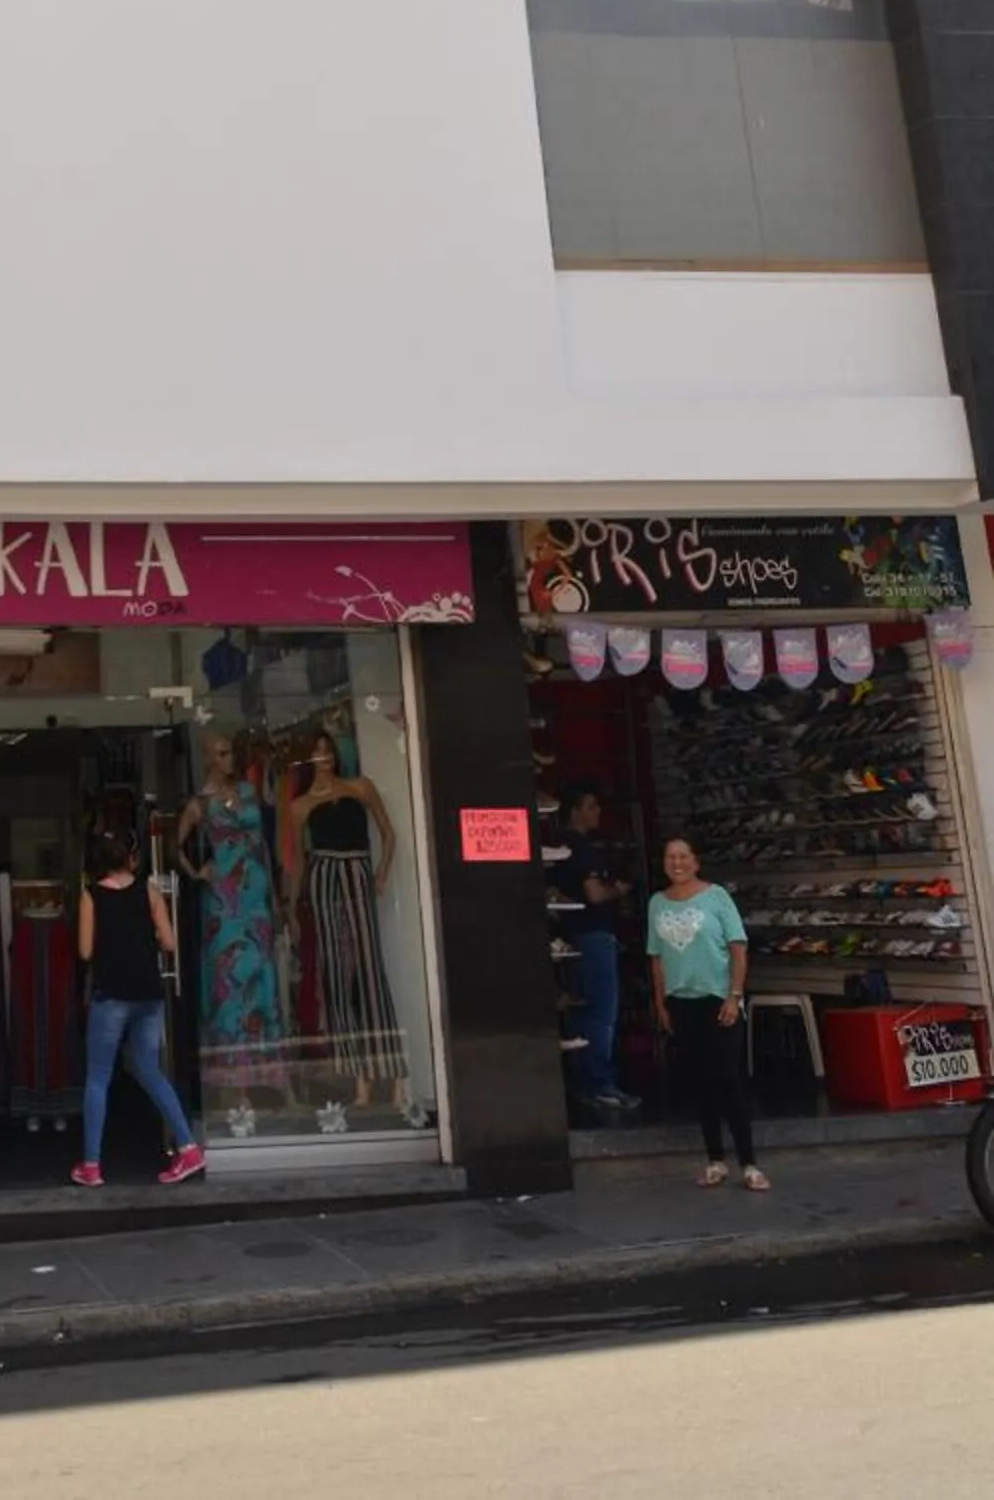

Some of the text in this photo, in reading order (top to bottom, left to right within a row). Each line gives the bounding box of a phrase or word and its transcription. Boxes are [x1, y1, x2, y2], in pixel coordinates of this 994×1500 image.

[719, 550, 798, 594] shoes
[123, 600, 188, 617] MODA
[911, 1054, 969, 1082] $10.000
